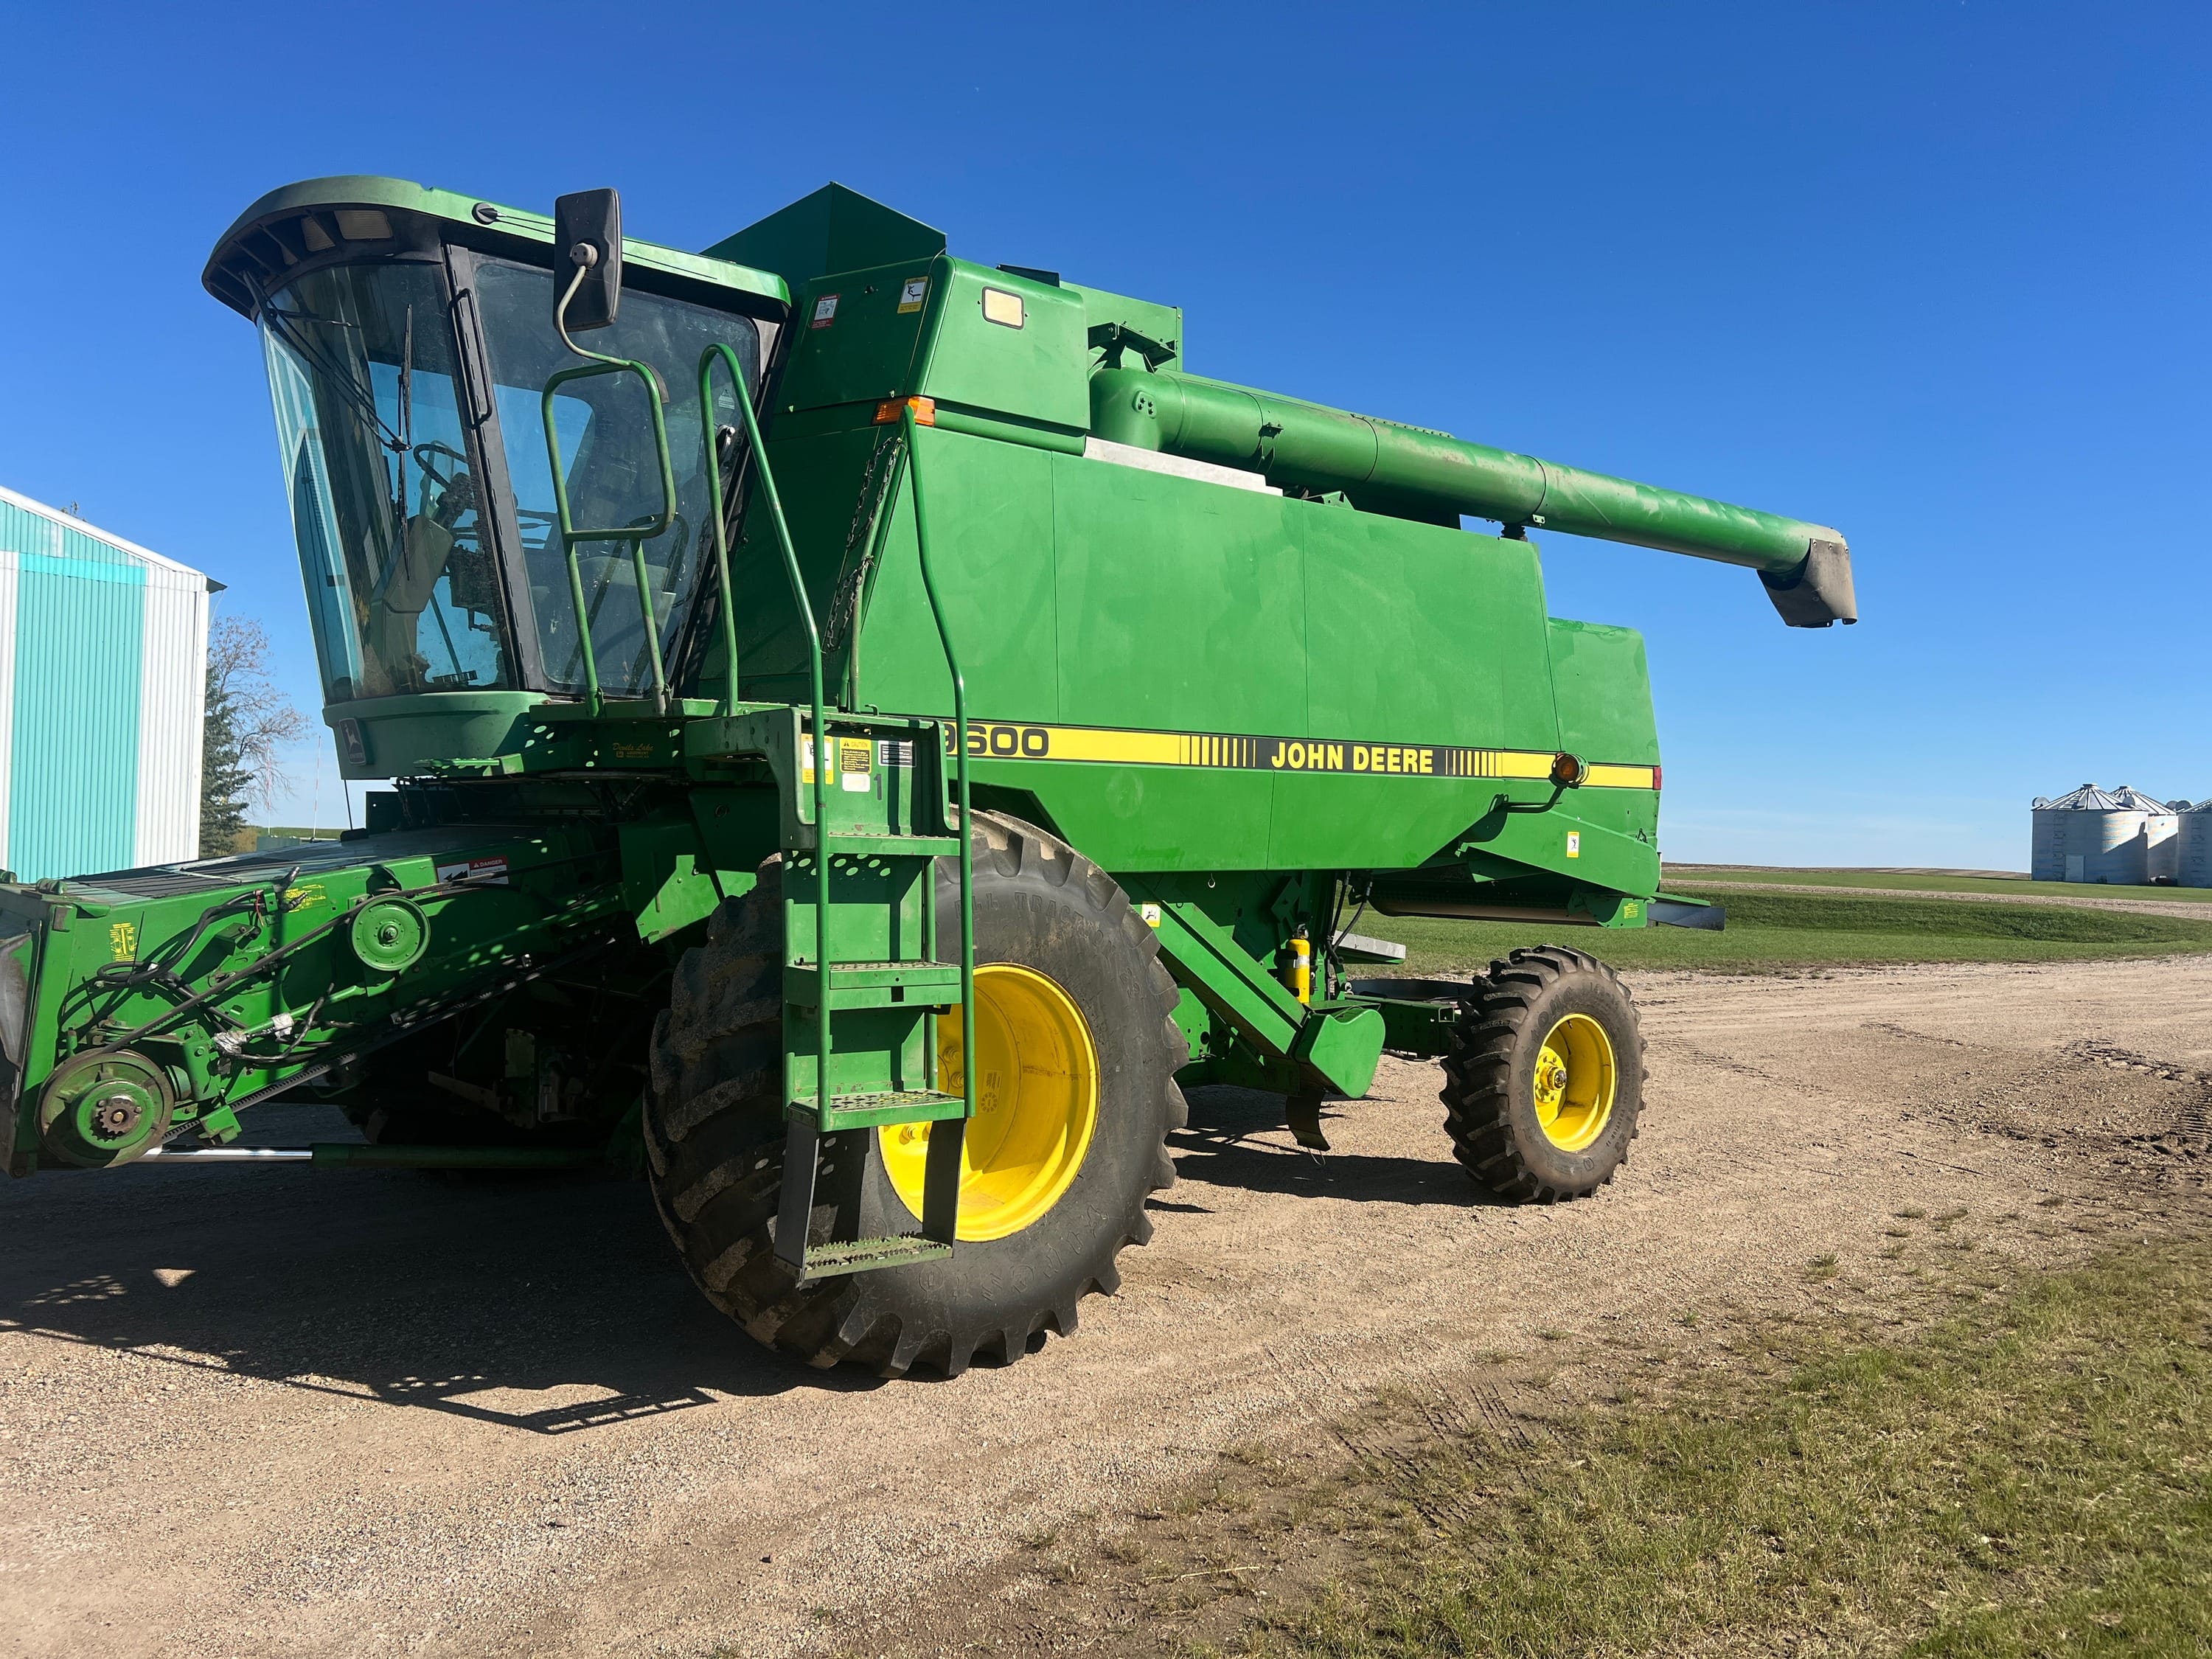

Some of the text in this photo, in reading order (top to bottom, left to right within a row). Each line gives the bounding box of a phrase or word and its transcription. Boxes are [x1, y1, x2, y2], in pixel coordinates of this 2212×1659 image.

[1271, 742, 1433, 773] JOHN DEERE
[480, 859, 503, 868] DANGER
